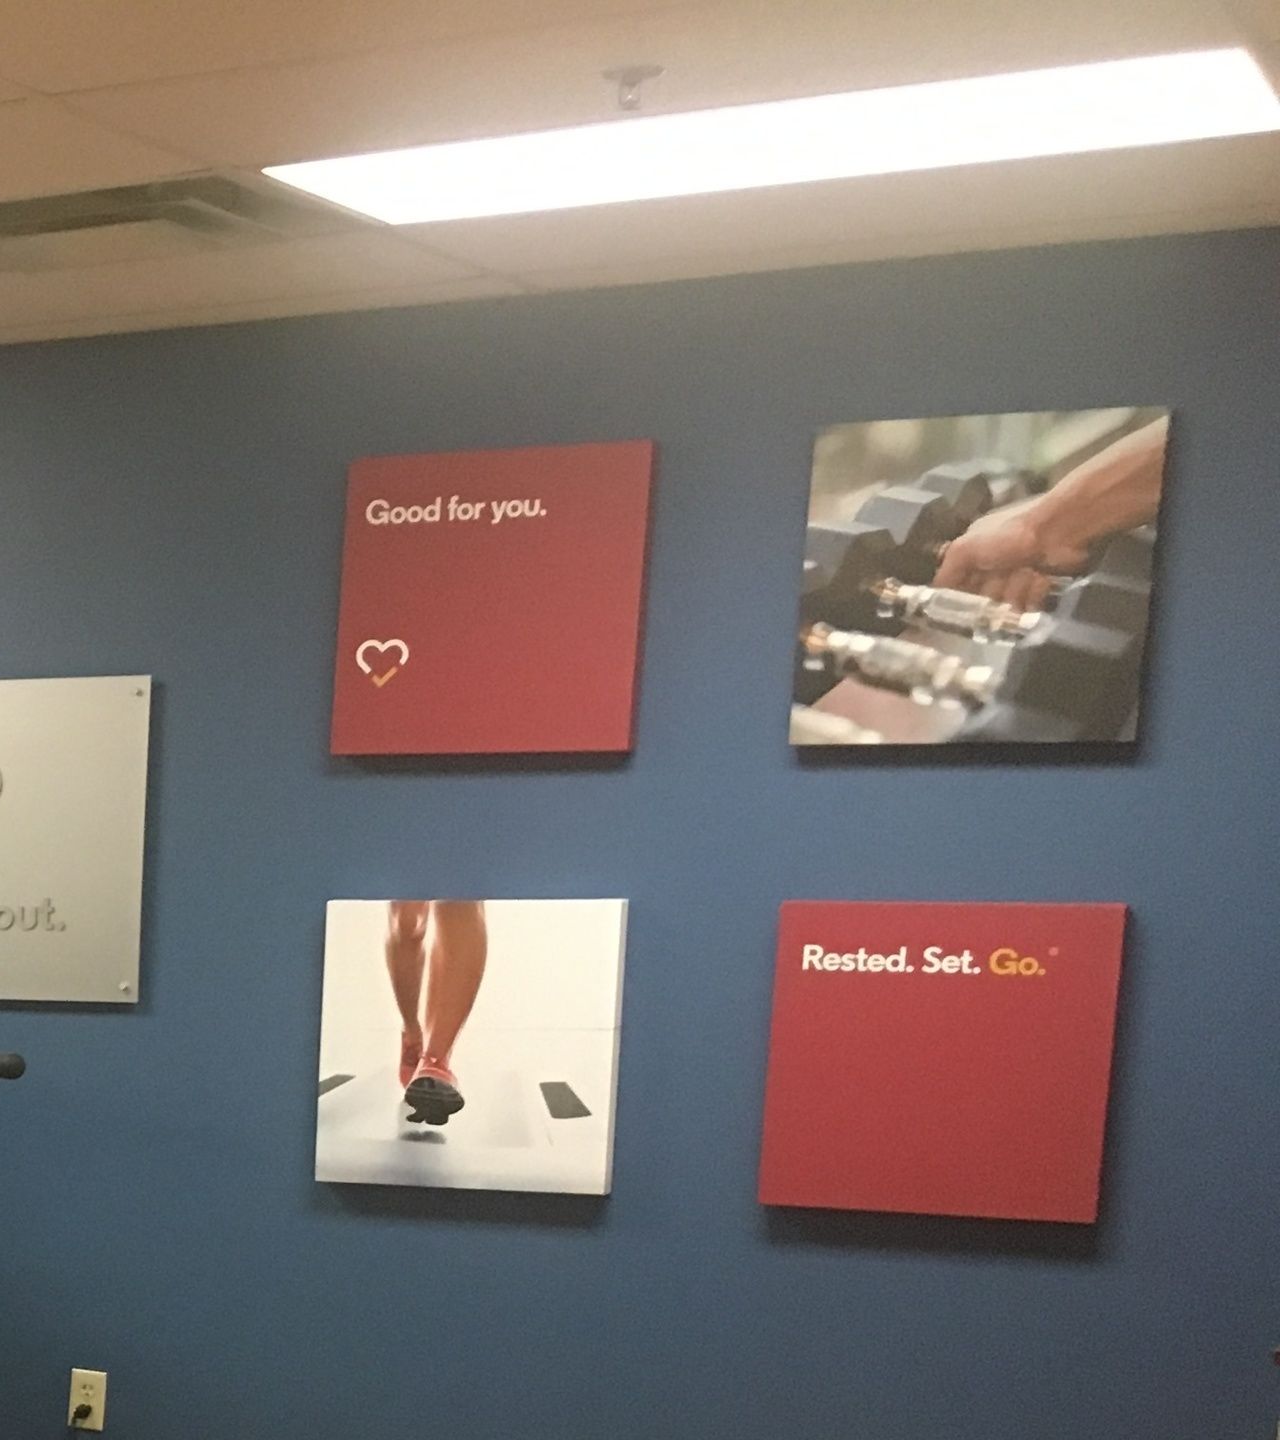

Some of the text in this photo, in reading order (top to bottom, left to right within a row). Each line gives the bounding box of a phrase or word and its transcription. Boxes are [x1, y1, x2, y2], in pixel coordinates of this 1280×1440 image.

[365, 495, 547, 525] Good for you.
[801, 944, 915, 973] Rested.
[921, 946, 982, 975] Set.
